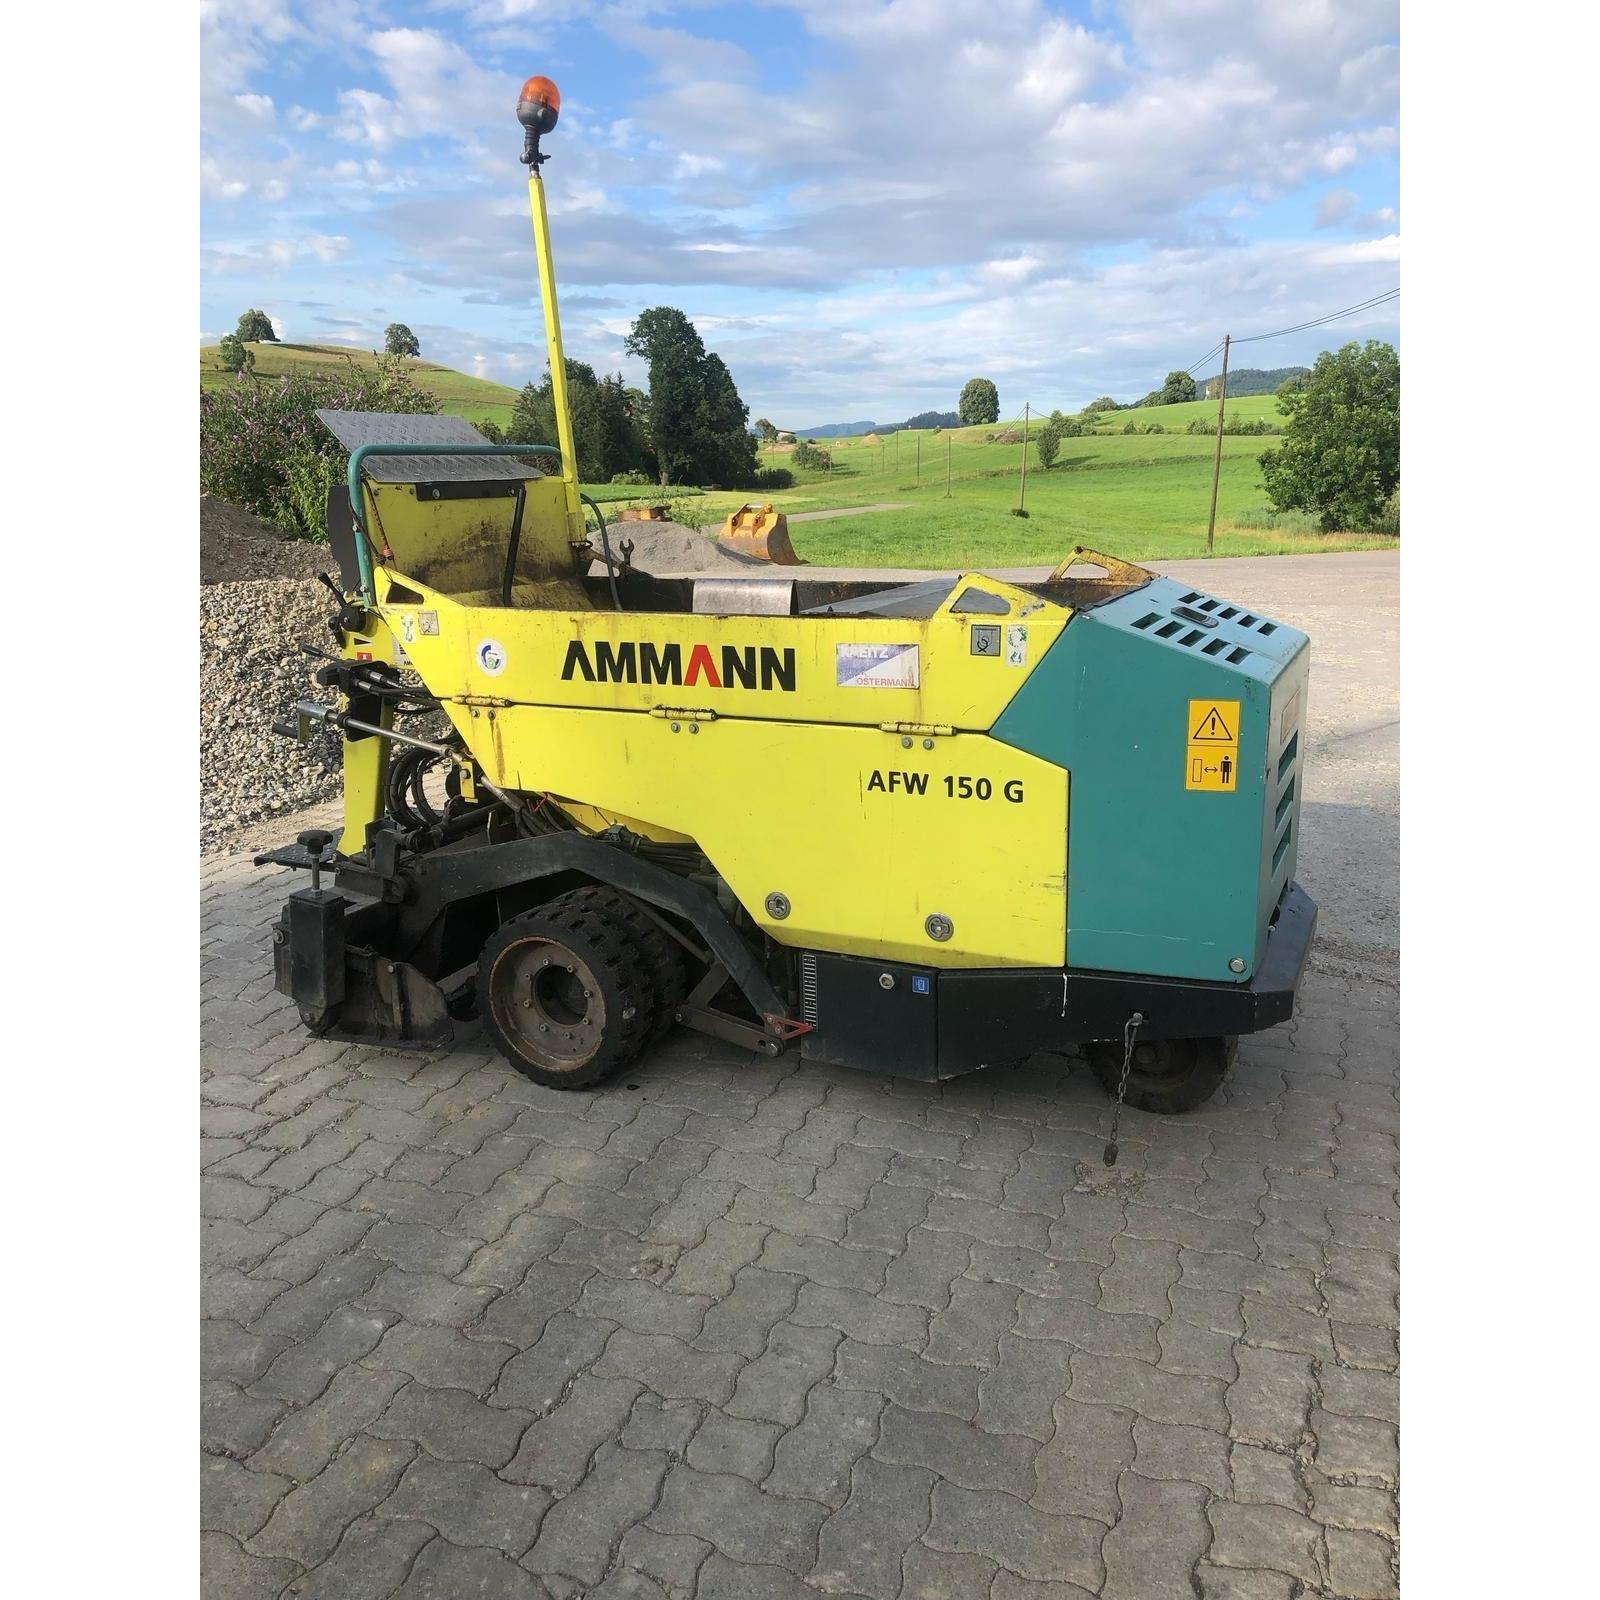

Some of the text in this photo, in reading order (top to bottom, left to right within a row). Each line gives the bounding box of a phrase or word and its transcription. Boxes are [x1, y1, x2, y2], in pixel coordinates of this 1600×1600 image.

[561, 640, 796, 691] AMMANN
[856, 677, 915, 687] OSTERMANN
[867, 770, 1024, 803] AFW 150 G
